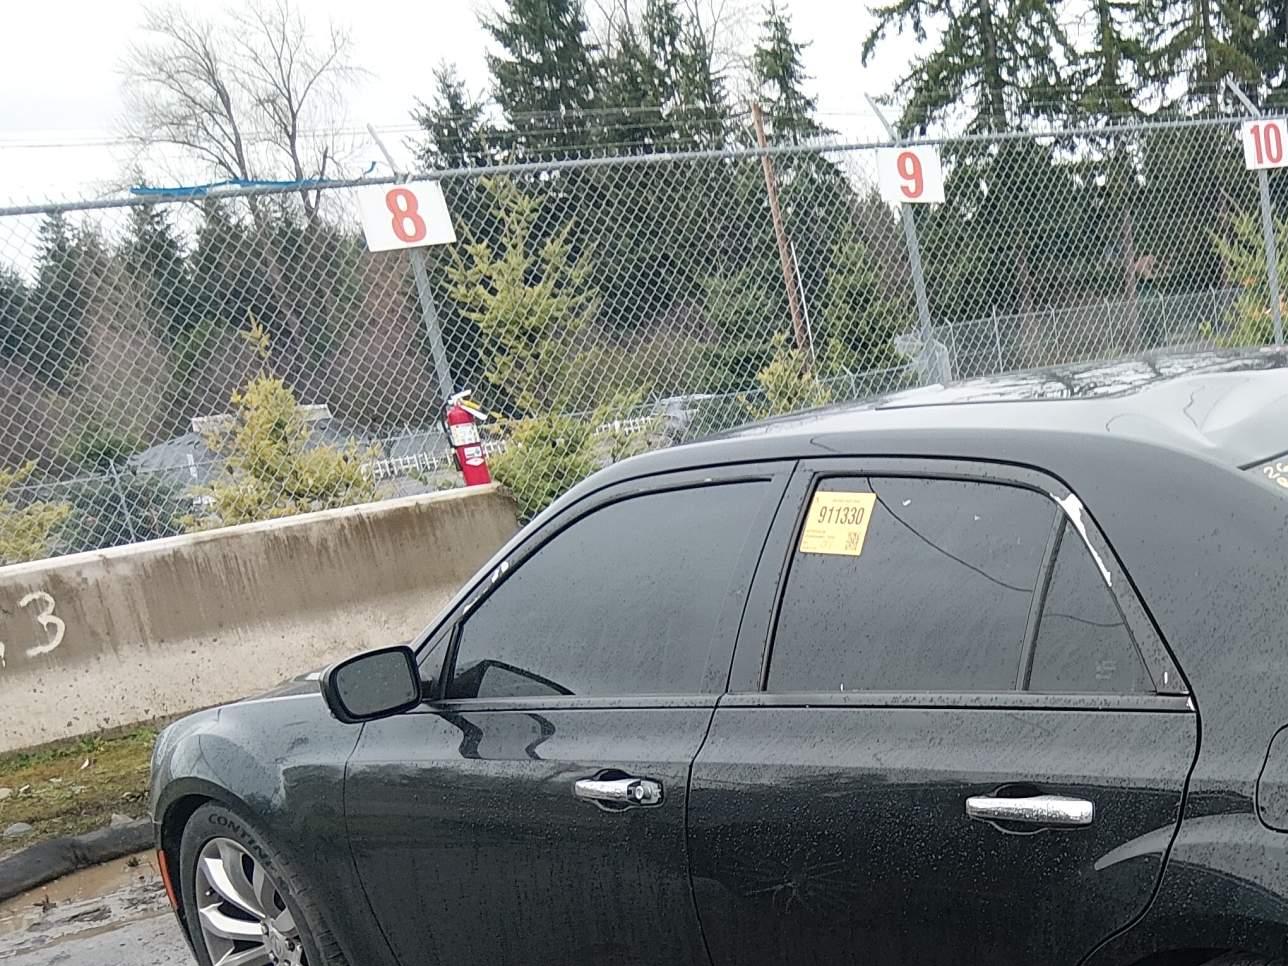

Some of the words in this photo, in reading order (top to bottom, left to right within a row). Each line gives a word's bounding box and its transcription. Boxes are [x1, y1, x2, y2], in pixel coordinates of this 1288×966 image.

[1250, 123, 1283, 165] 10
[897, 151, 924, 199] 9
[385, 187, 427, 243] 8
[817, 505, 865, 525] 911330
